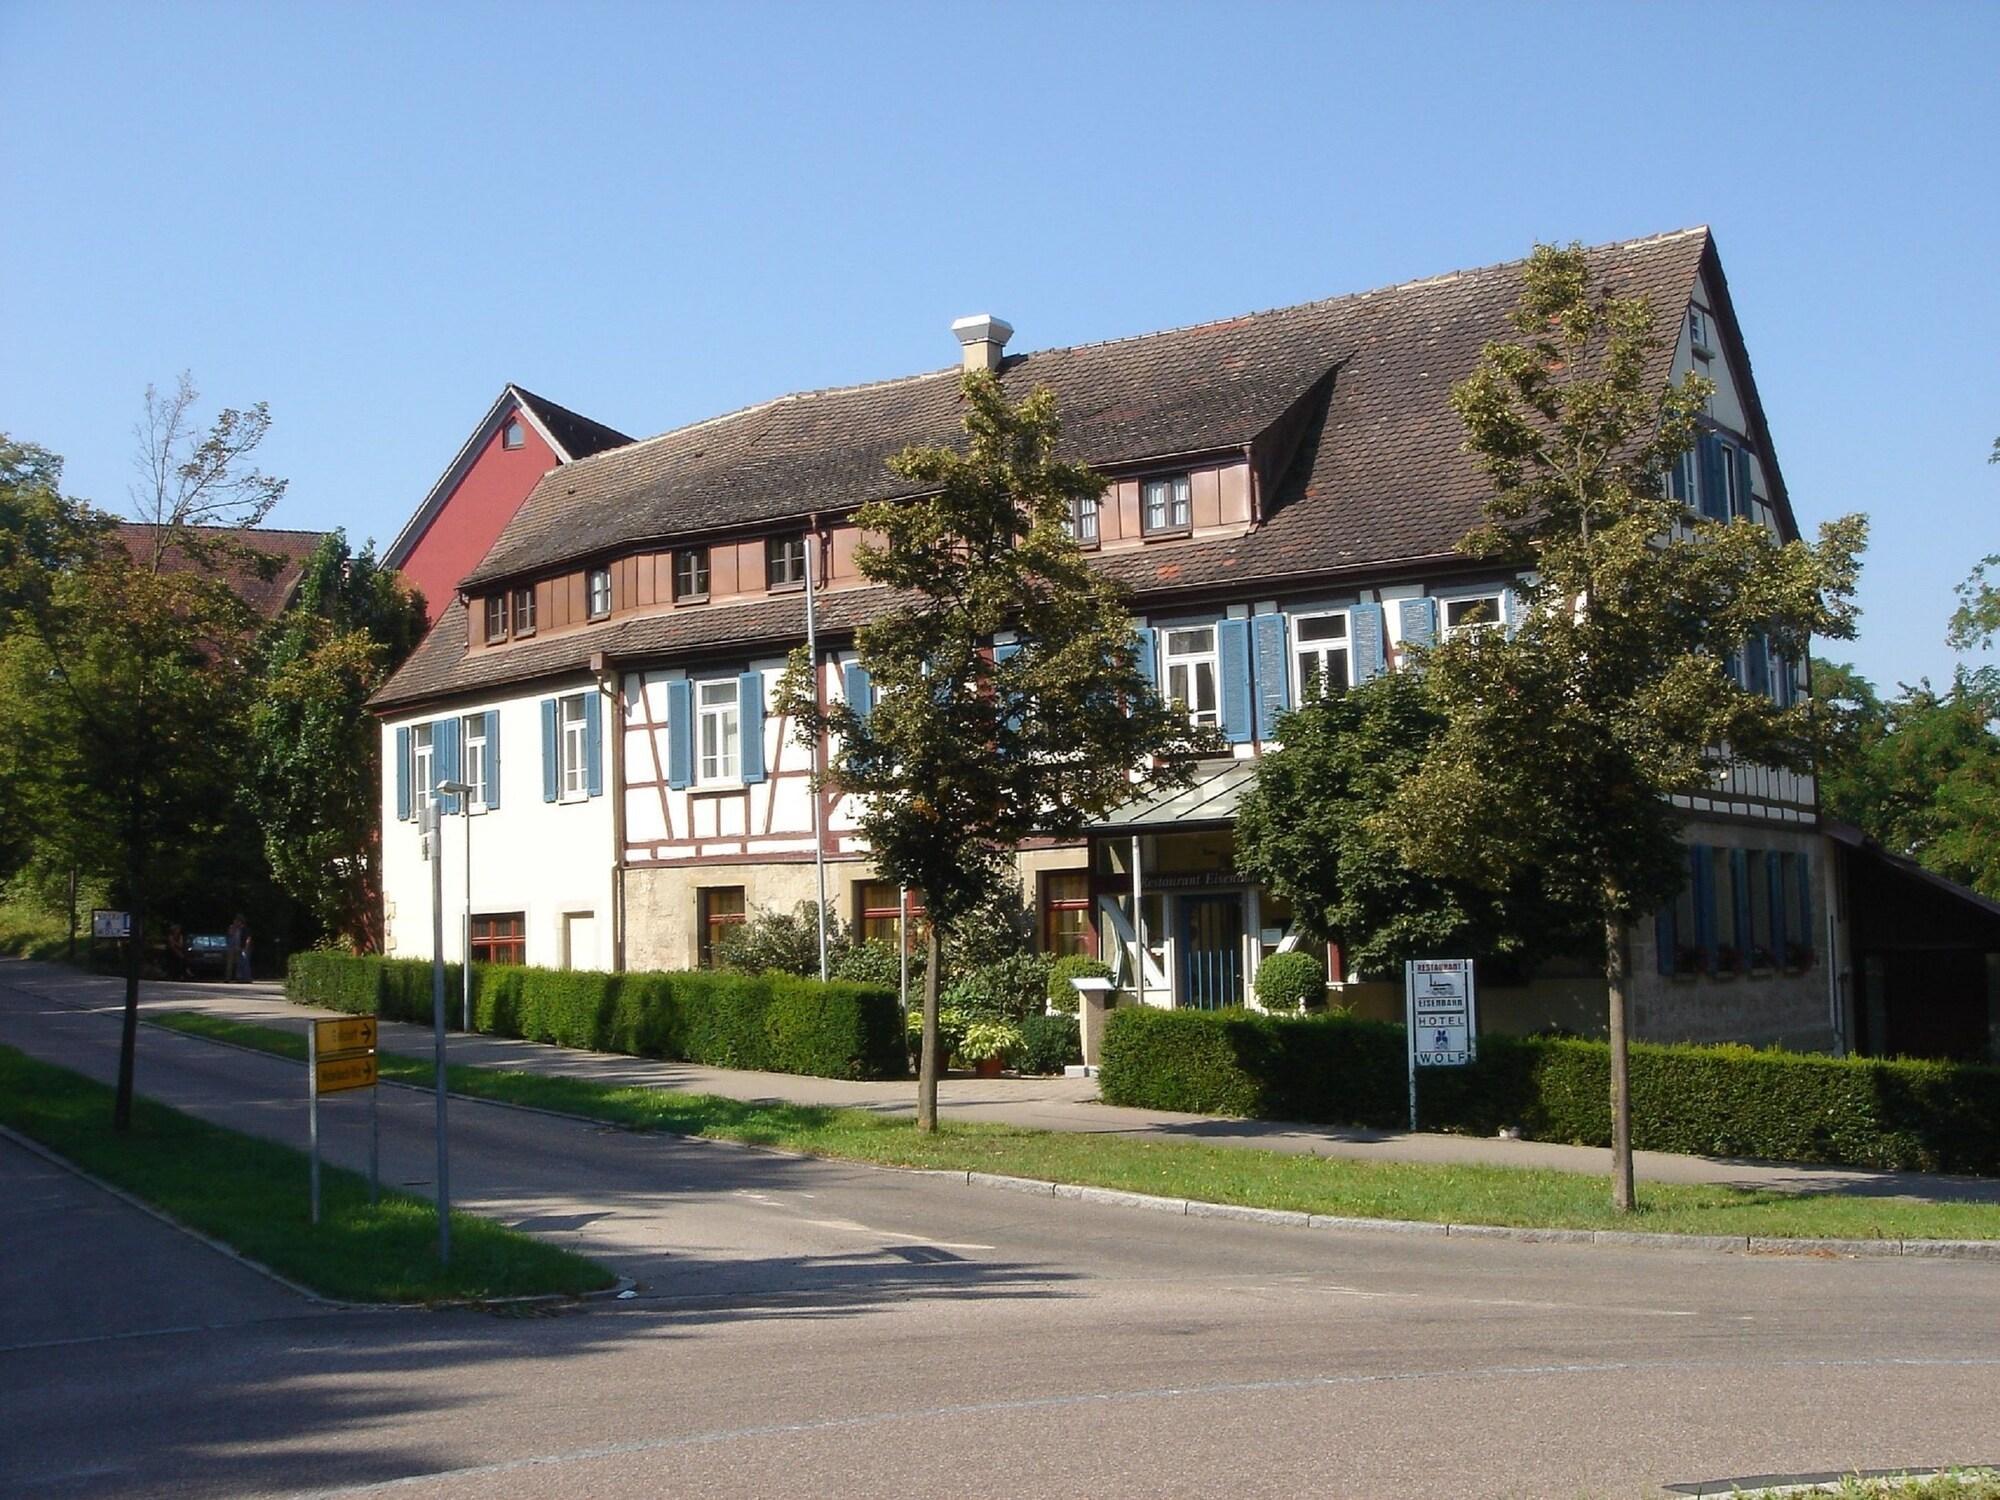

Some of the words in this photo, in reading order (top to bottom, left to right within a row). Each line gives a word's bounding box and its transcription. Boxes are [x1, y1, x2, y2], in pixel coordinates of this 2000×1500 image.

[1417, 962, 1462, 972] RESTAURANT
[1418, 999, 1463, 1008] EISENBAHN
[1419, 1016, 1465, 1026] HOTEL
[1420, 1052, 1466, 1064] WOLF
